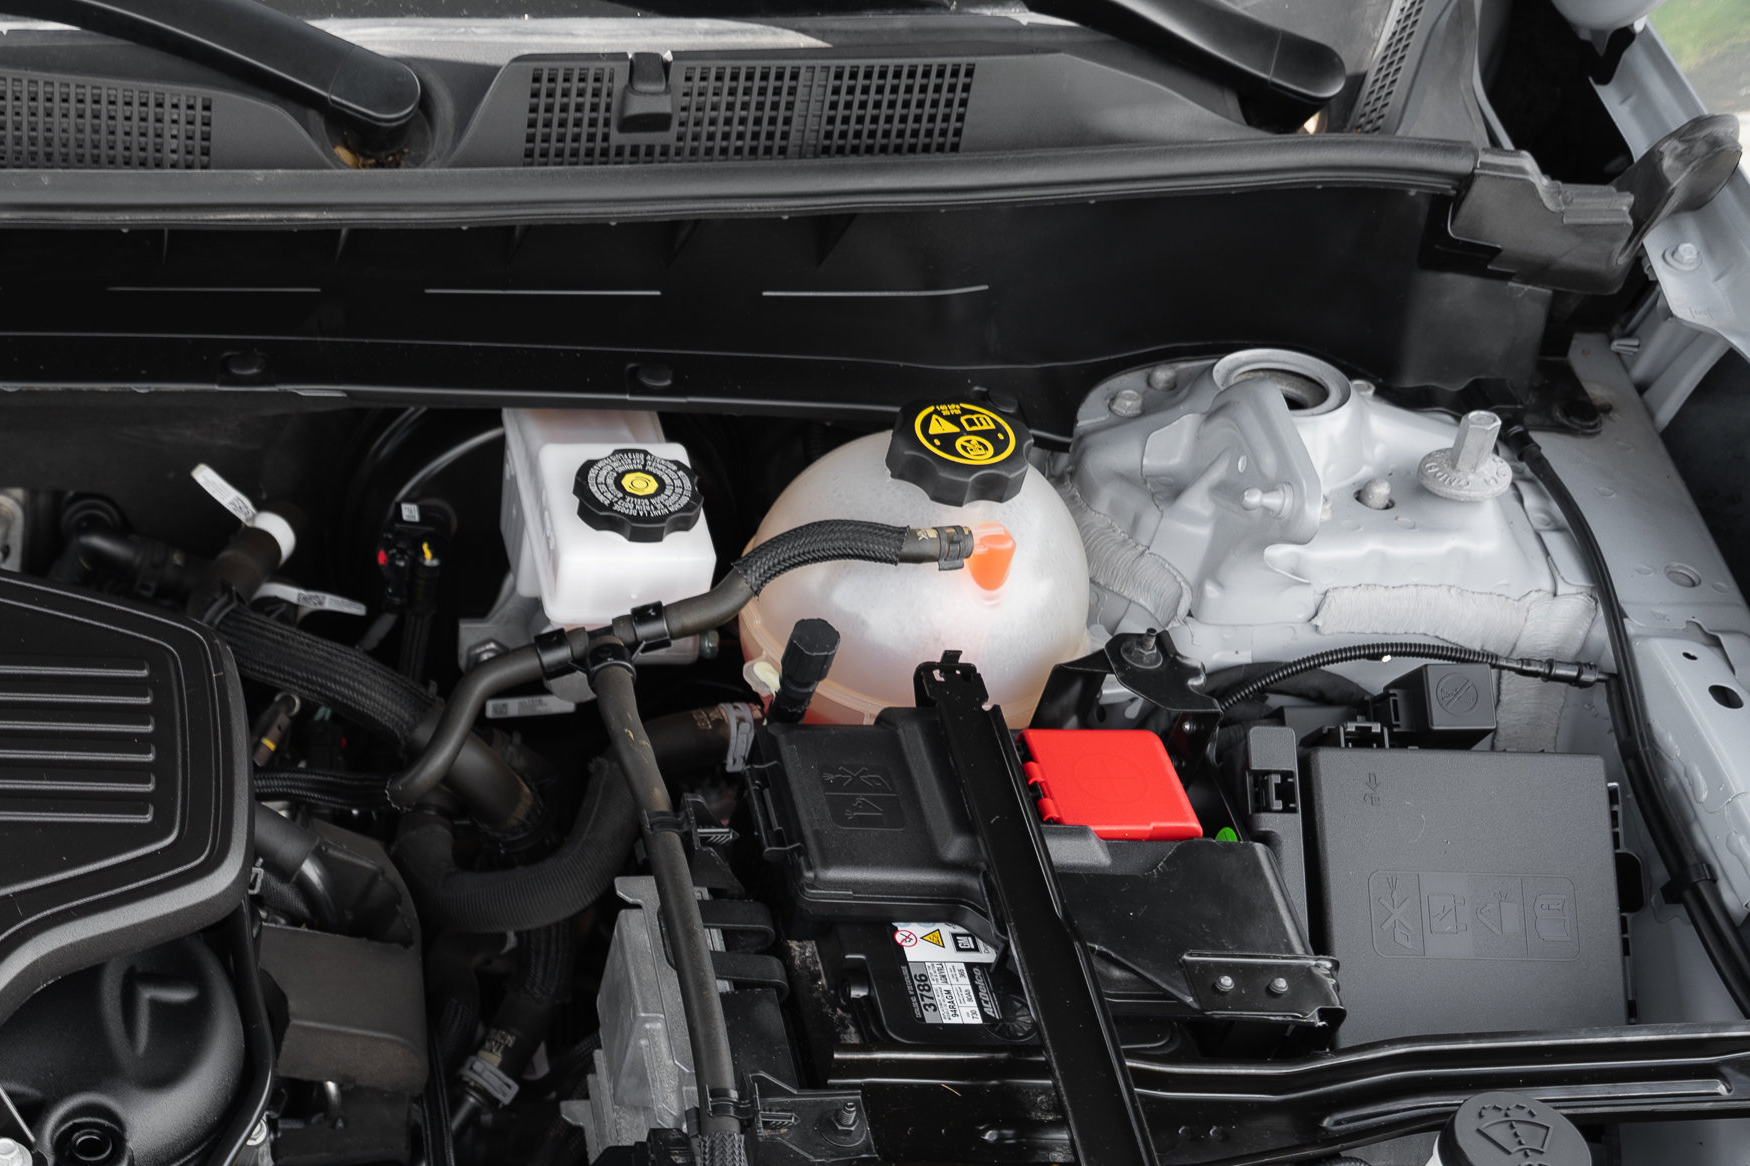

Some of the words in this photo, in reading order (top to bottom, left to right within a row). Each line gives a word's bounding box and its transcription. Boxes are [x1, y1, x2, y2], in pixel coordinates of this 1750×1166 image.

[956, 937, 975, 949] GM
[914, 973, 938, 1013] 3786
[943, 989, 959, 1018] 94RAGM
[973, 967, 995, 1018] ACDelco
[970, 1009, 979, 1019] 730
